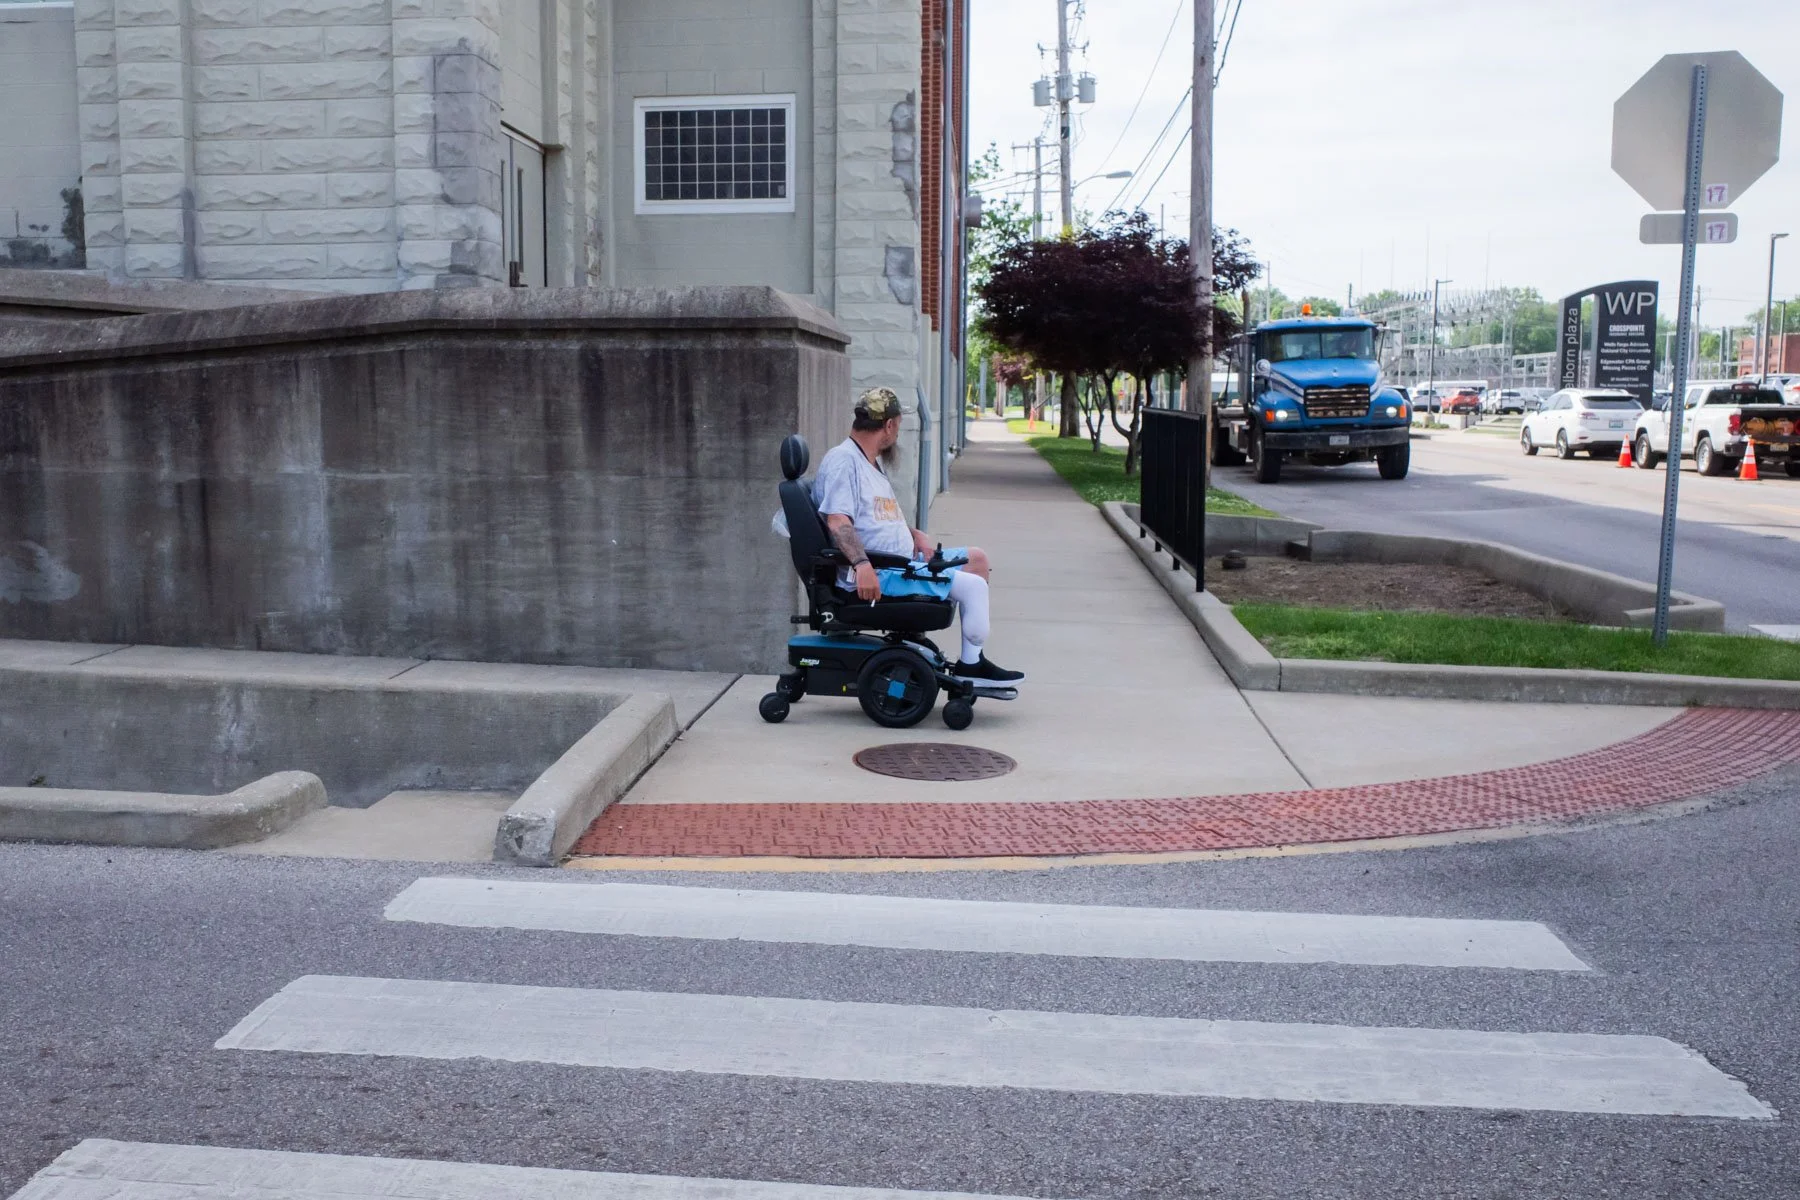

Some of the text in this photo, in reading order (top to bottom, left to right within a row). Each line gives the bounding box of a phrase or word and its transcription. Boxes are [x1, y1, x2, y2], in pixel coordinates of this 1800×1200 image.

[1707, 185, 1726, 202] 17
[1708, 223, 1726, 241] 17
[1605, 292, 1656, 315] WP
[1562, 308, 1579, 389] elborn plaza
[1308, 410, 1367, 418] MACK
